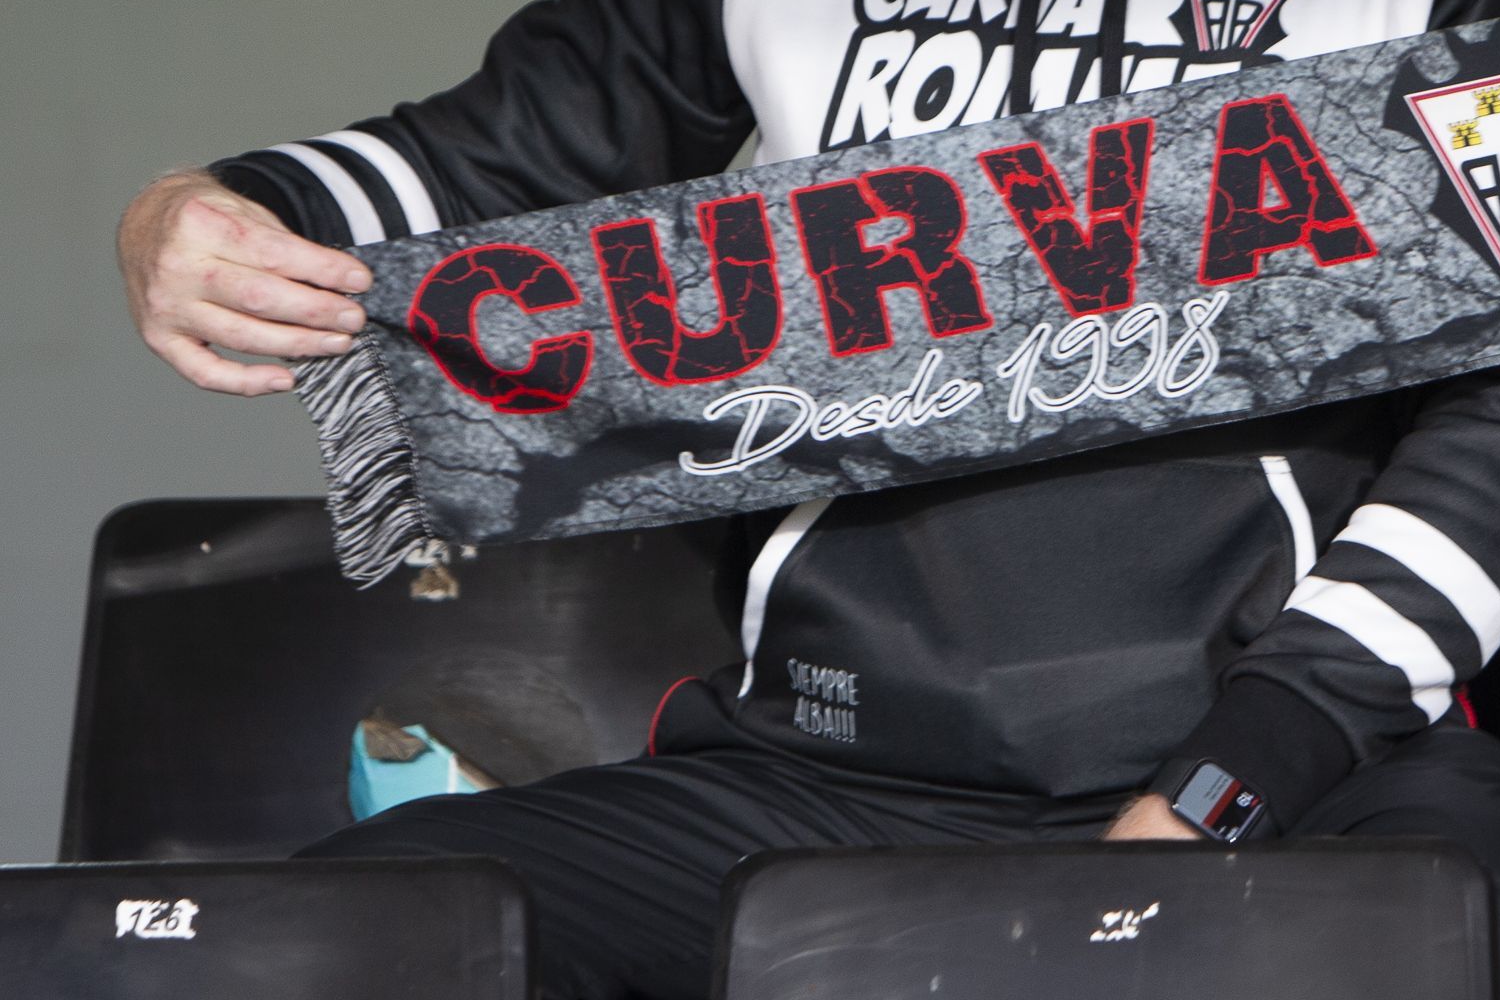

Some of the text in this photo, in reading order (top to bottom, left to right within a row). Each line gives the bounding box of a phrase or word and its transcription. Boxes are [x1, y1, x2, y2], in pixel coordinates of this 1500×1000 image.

[409, 92, 1376, 415] CURVA
[678, 289, 1232, 476] Desde 1998
[786, 657, 860, 705] SIEMPRE
